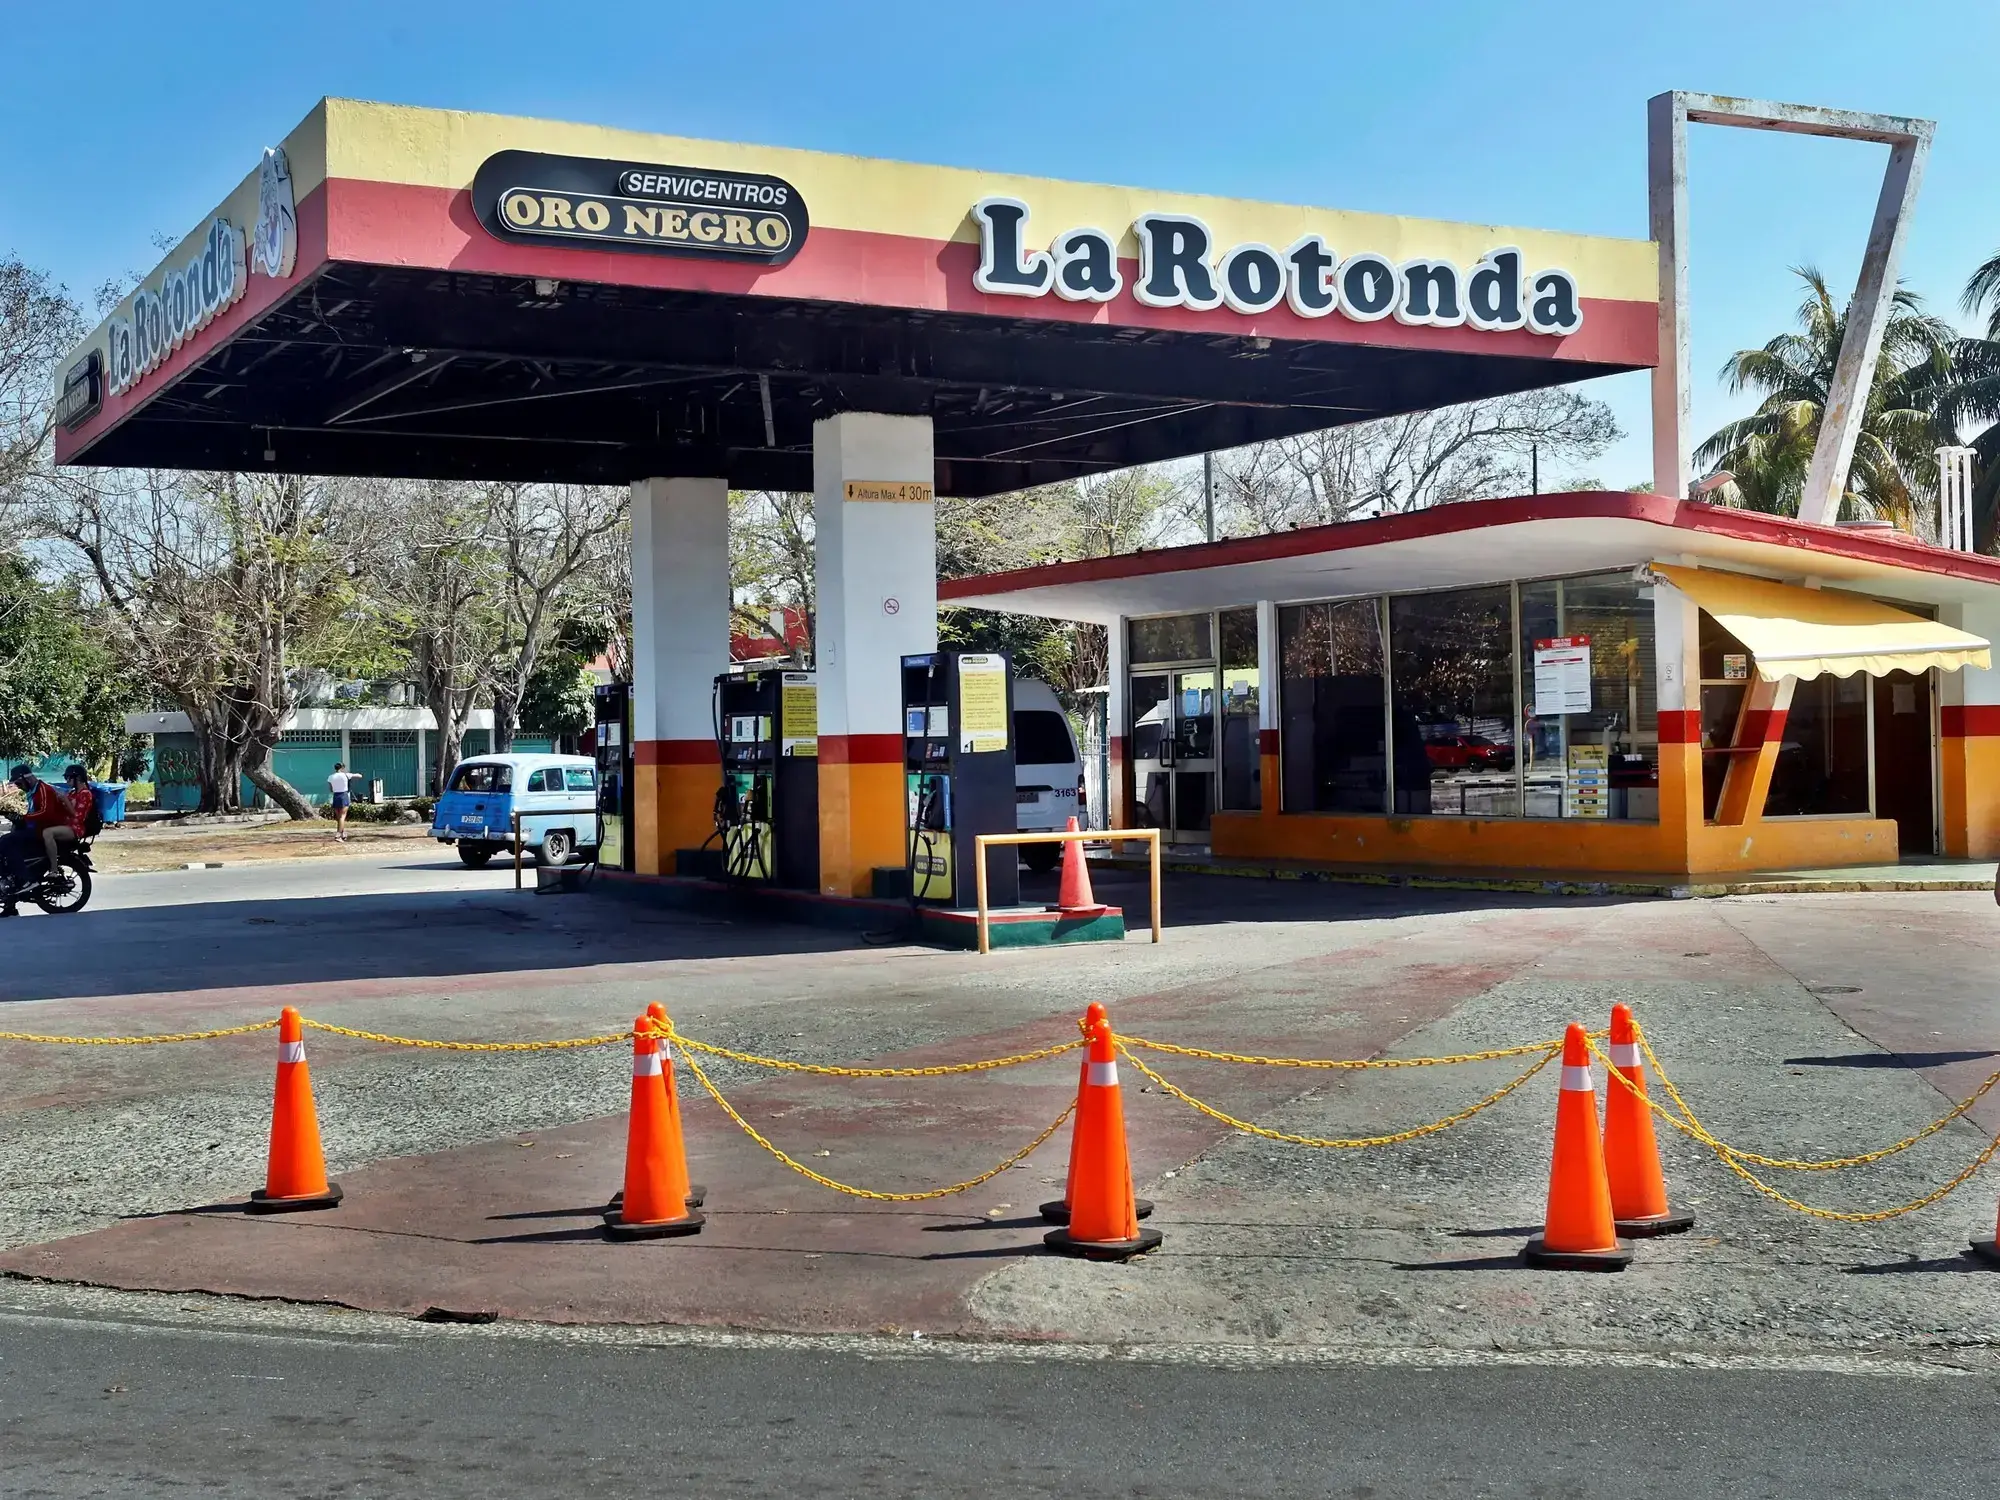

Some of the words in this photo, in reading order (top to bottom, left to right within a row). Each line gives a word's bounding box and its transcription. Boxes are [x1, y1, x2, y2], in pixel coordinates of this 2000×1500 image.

[628, 173, 788, 205] SERVICENTROS
[506, 194, 610, 232] ORO
[622, 205, 787, 247] NEGRO
[980, 201, 1118, 297] La
[1140, 216, 1580, 331] Rotonda
[108, 321, 131, 391] La
[133, 221, 234, 370] Rotonda
[858, 488, 879, 499] Altura
[881, 489, 896, 500] Max
[1055, 789, 1076, 798] 3163
